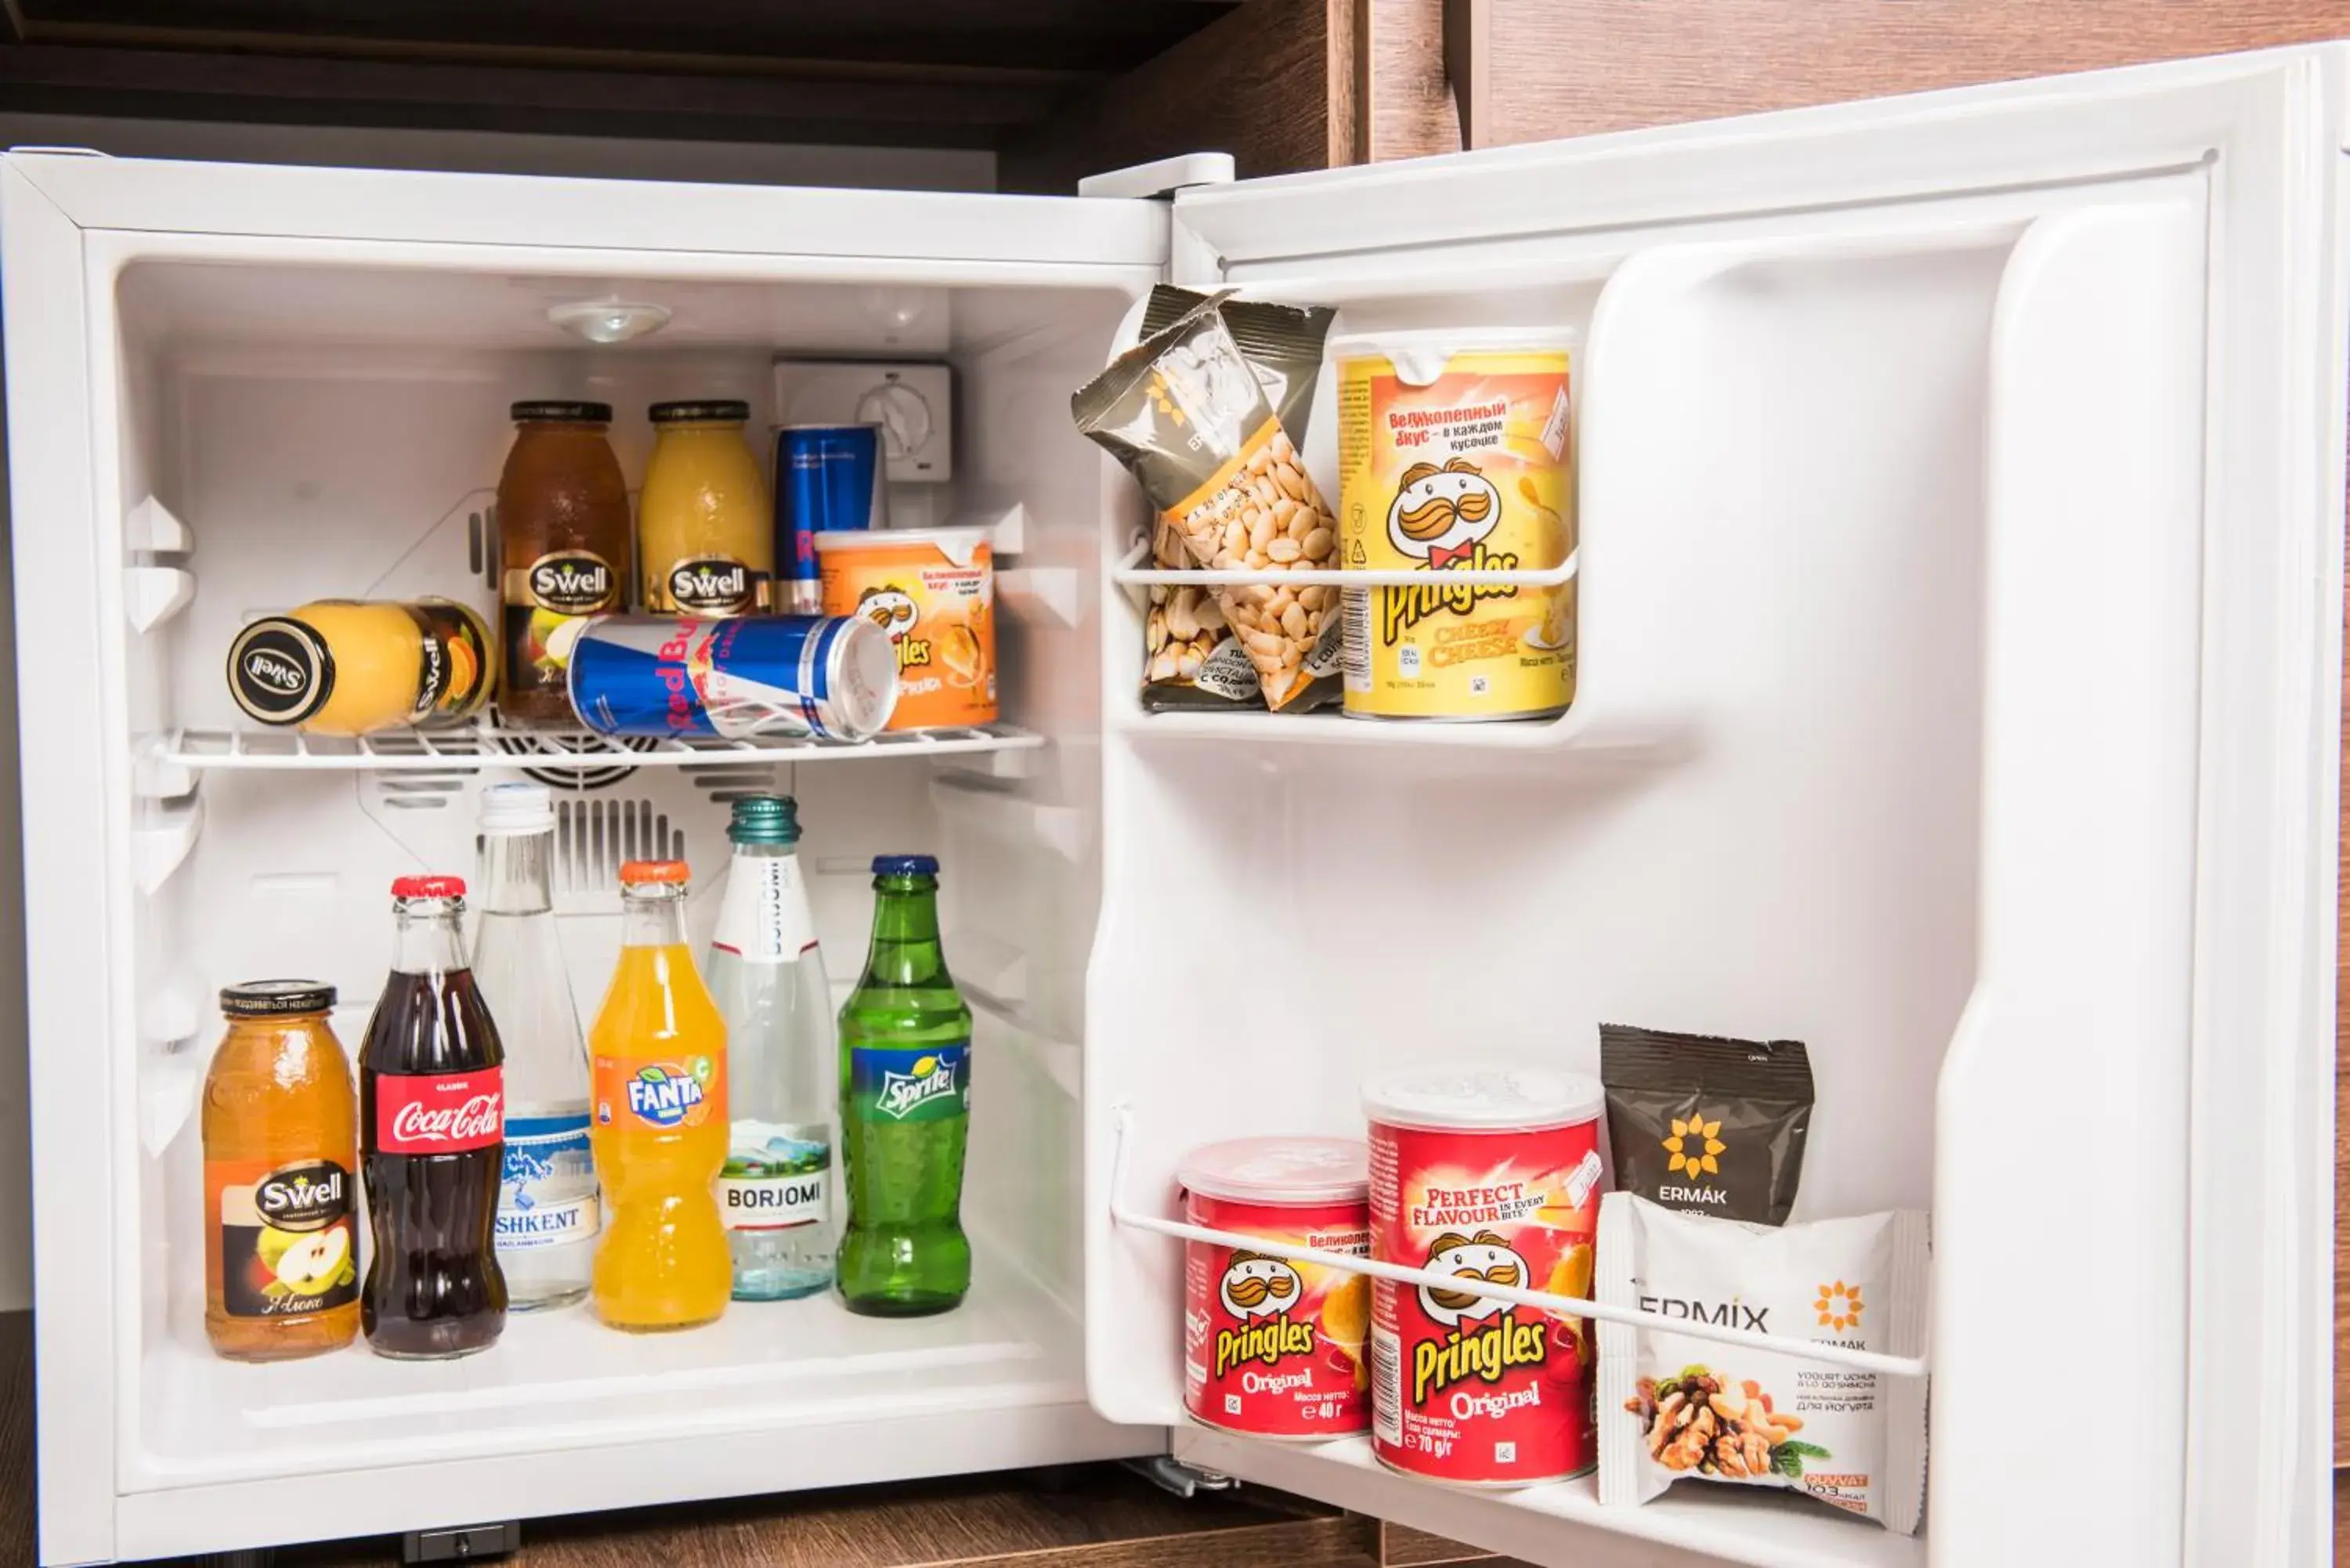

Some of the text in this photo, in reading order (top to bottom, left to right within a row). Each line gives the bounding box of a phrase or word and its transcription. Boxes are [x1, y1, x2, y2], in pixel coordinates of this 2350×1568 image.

[1453, 421, 1503, 437] каждом
[537, 565, 606, 594] Swell
[674, 565, 745, 598] Swell
[250, 656, 301, 688] Swell
[418, 637, 440, 709] Swell
[628, 1076, 703, 1111] FANTA
[886, 1065, 950, 1111] Sprite
[392, 1092, 501, 1141] Coca-Cola
[264, 1171, 342, 1212] Swell
[728, 1181, 820, 1208] BORJOMI
[1426, 1182, 1524, 1209] PERFECT
[1500, 1194, 1545, 1212] IN EVERY
[496, 1208, 580, 1234] SHKENT
[1412, 1206, 1501, 1227] FLAVOUR
[1217, 1314, 1314, 1378] Pringles
[1413, 1313, 1548, 1406] Pringles
[1242, 1367, 1314, 1395] Original
[1451, 1380, 1541, 1420] Original
